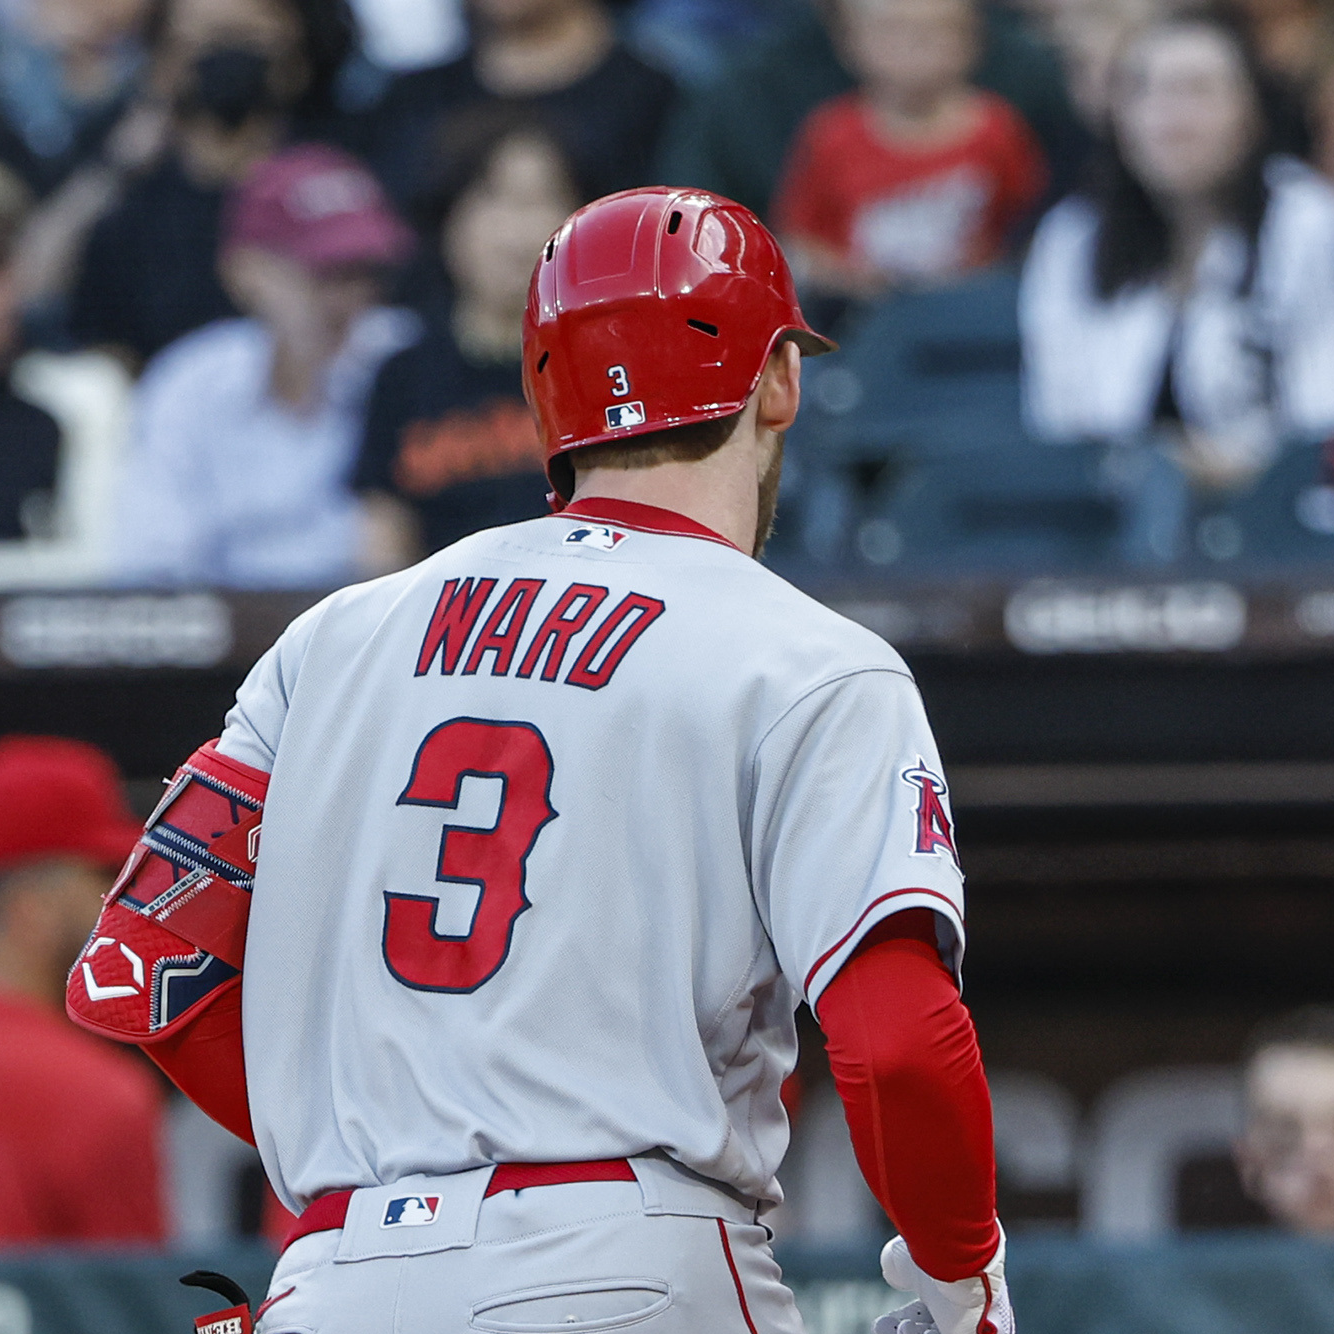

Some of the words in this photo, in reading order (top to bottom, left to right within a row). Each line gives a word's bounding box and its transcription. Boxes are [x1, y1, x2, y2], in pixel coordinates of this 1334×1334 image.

[607, 364, 631, 397] 3
[414, 576, 666, 692] WARD
[147, 871, 201, 913] EVOSHIELD
[381, 716, 559, 994] 3
